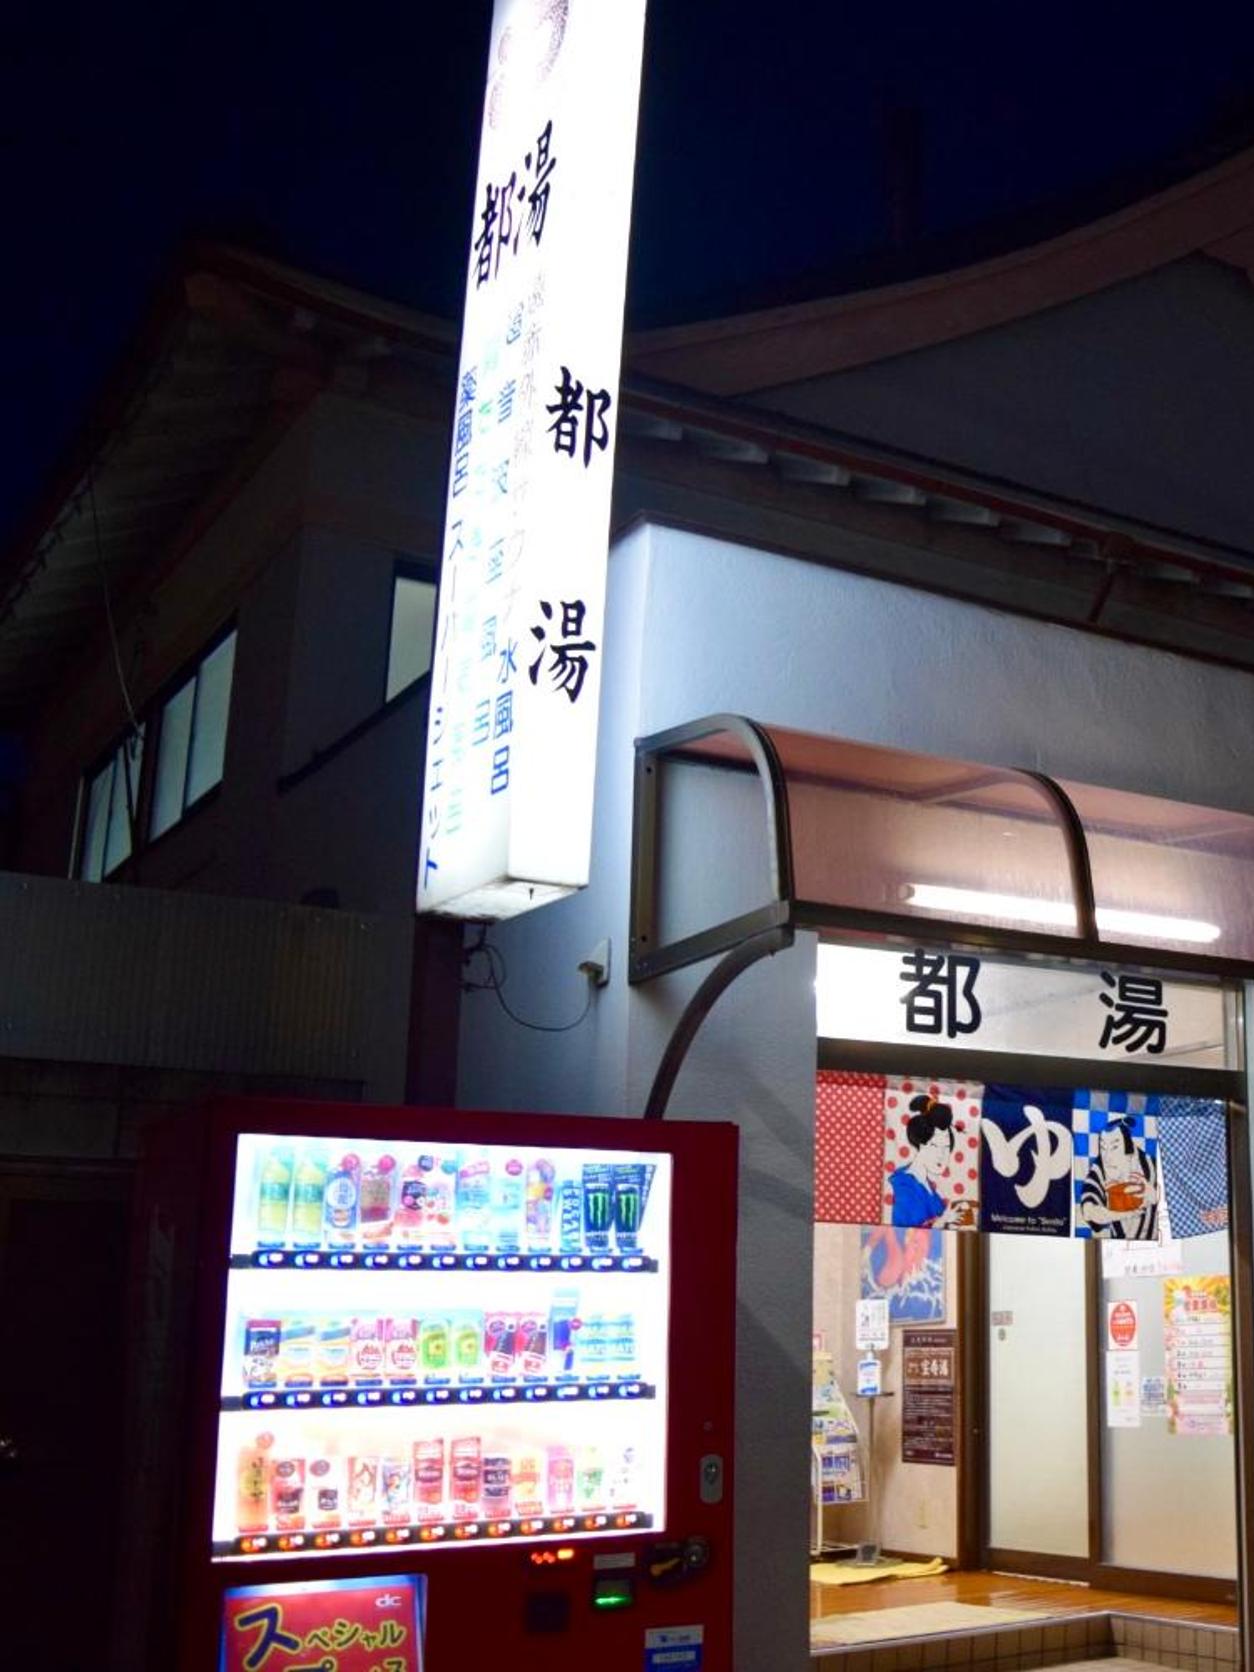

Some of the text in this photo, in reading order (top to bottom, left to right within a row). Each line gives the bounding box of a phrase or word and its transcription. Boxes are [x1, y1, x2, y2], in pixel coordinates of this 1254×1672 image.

[473, 119, 557, 289] 都湯
[899, 949, 1169, 1055] 都湯
[981, 1105, 1073, 1209] ゆ
[236, 1603, 407, 1669] スペシャル
